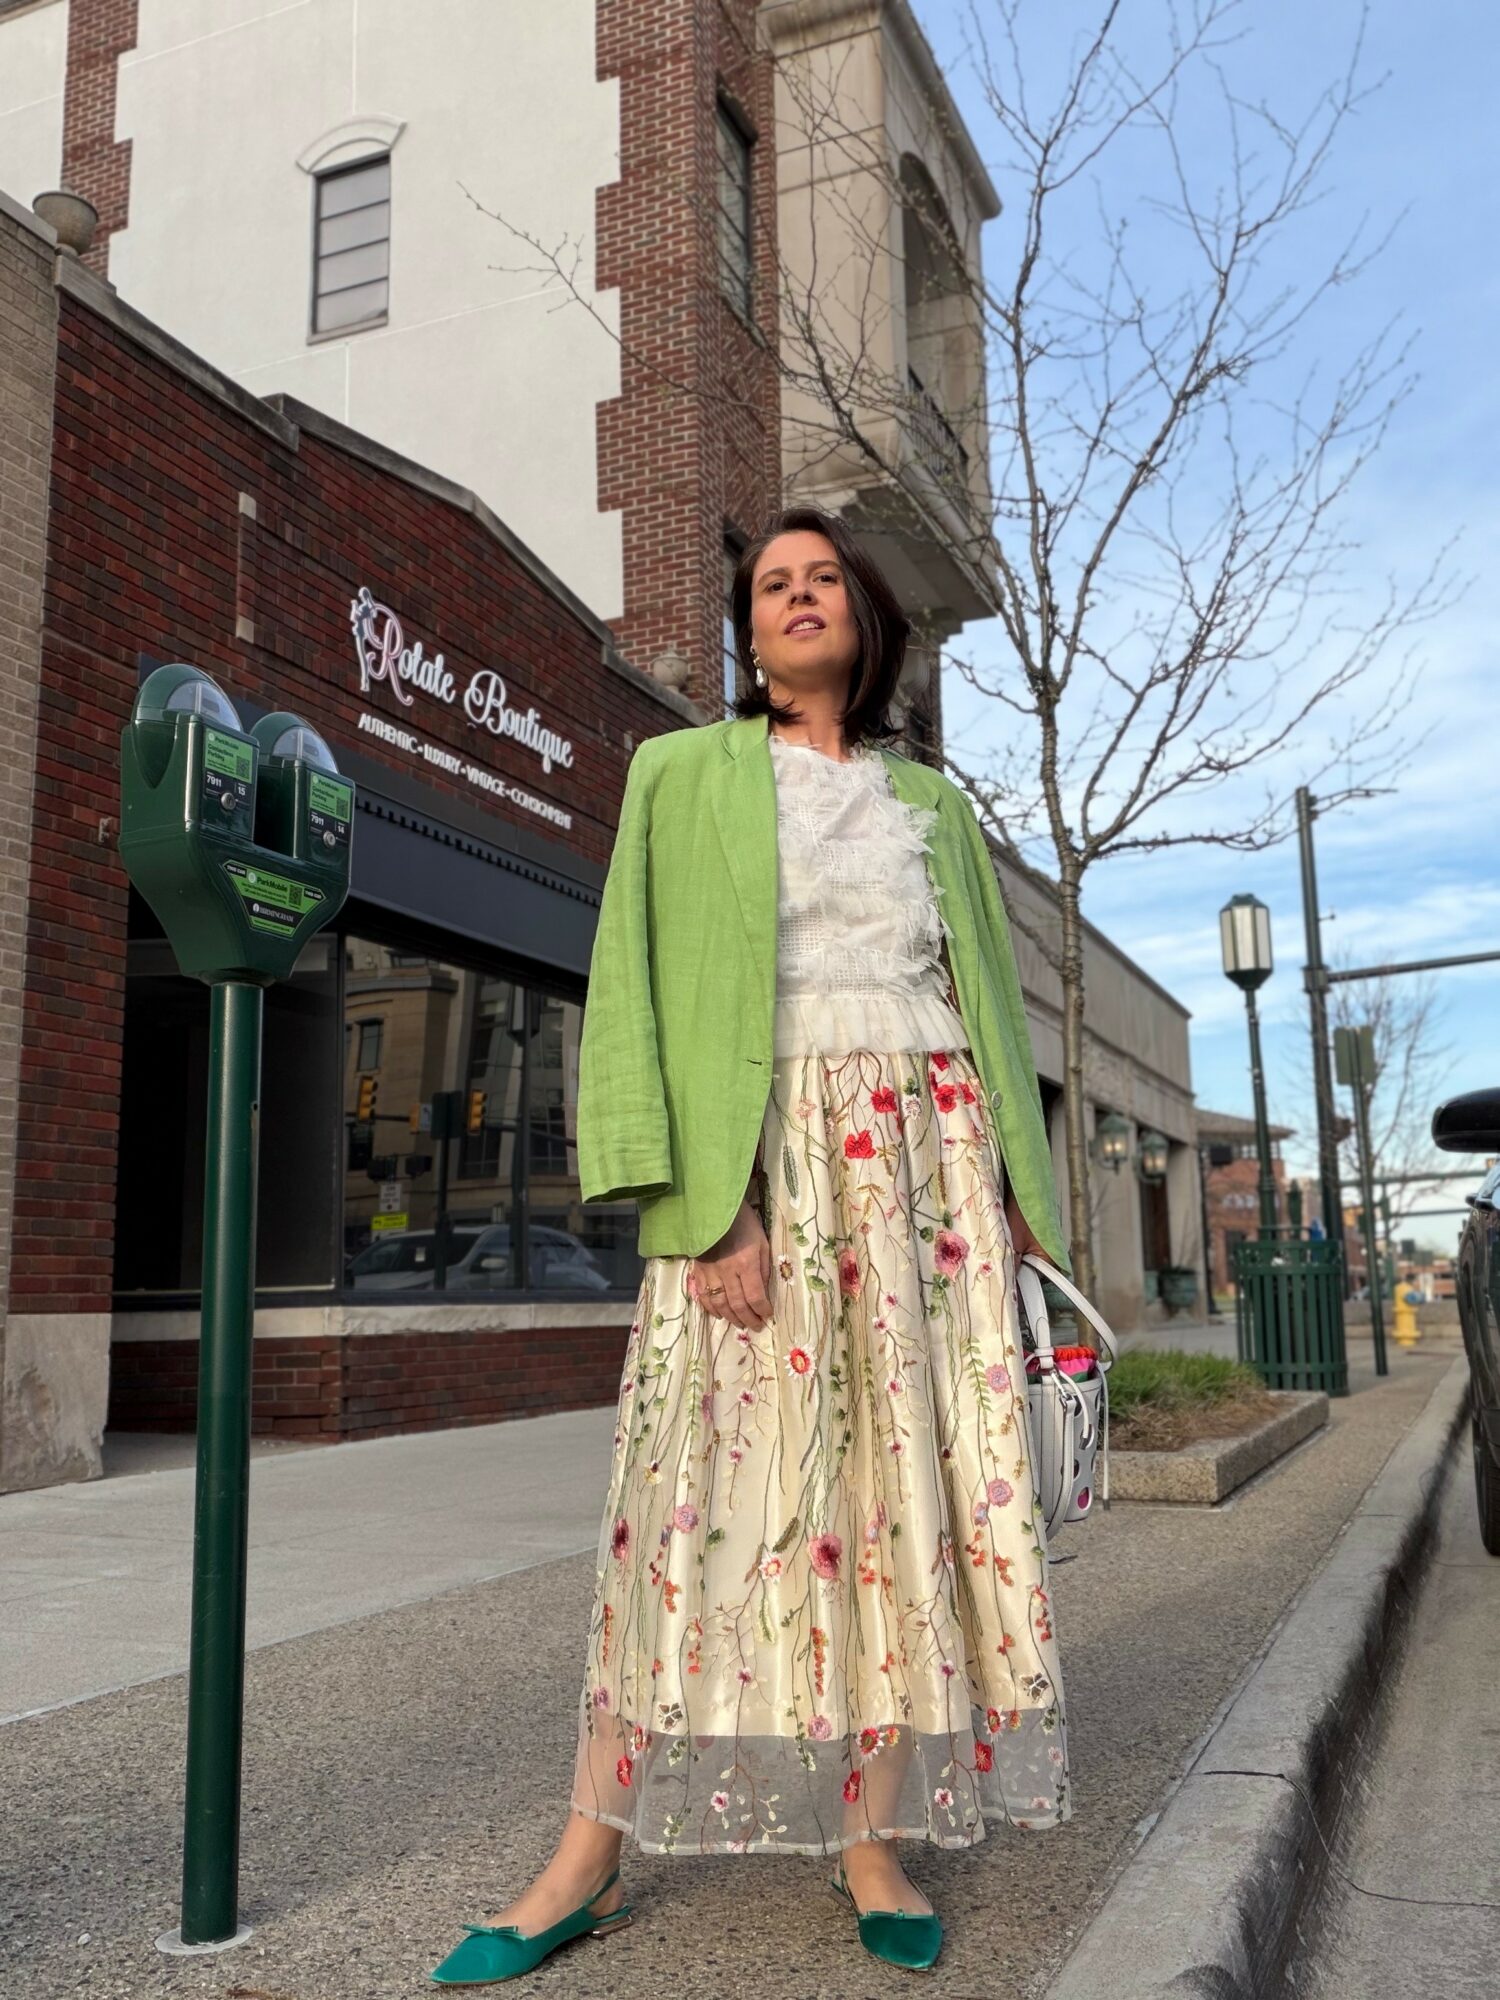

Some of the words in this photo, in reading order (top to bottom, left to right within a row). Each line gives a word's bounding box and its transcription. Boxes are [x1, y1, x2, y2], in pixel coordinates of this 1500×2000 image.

[363, 603, 456, 706] Rotate
[464, 670, 573, 774] Boutique
[358, 713, 418, 753] AUTHENTIC
[424, 744, 461, 775] LUXURY
[466, 764, 506, 797] VINTAGE
[511, 788, 572, 830] CONSIGNMENT
[206, 774, 222, 787] 7911
[238, 786, 246, 796] 15
[311, 814, 325, 826] 7911
[257, 876, 288, 893] ParkMobile
